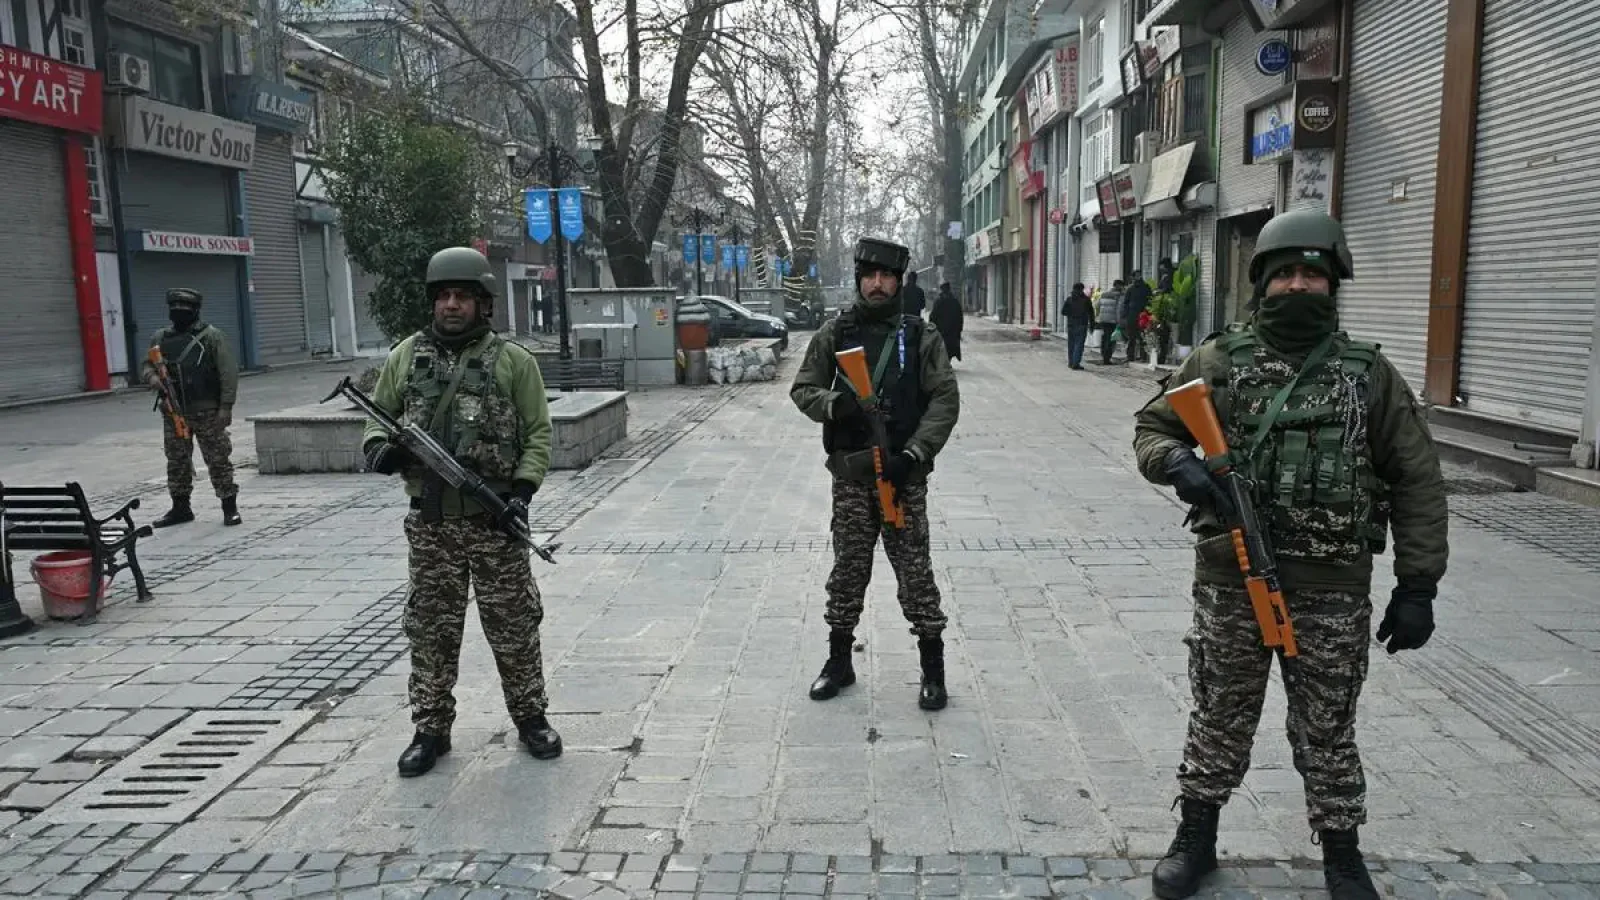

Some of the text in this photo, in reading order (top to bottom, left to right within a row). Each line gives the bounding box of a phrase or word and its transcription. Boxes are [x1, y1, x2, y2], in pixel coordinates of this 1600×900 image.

[32, 79, 83, 115] ART
[1304, 106, 1329, 117] COFFEE
[140, 110, 252, 163] Victor Sons
[148, 233, 204, 250] VICTOR
[207, 238, 237, 252] SONS
